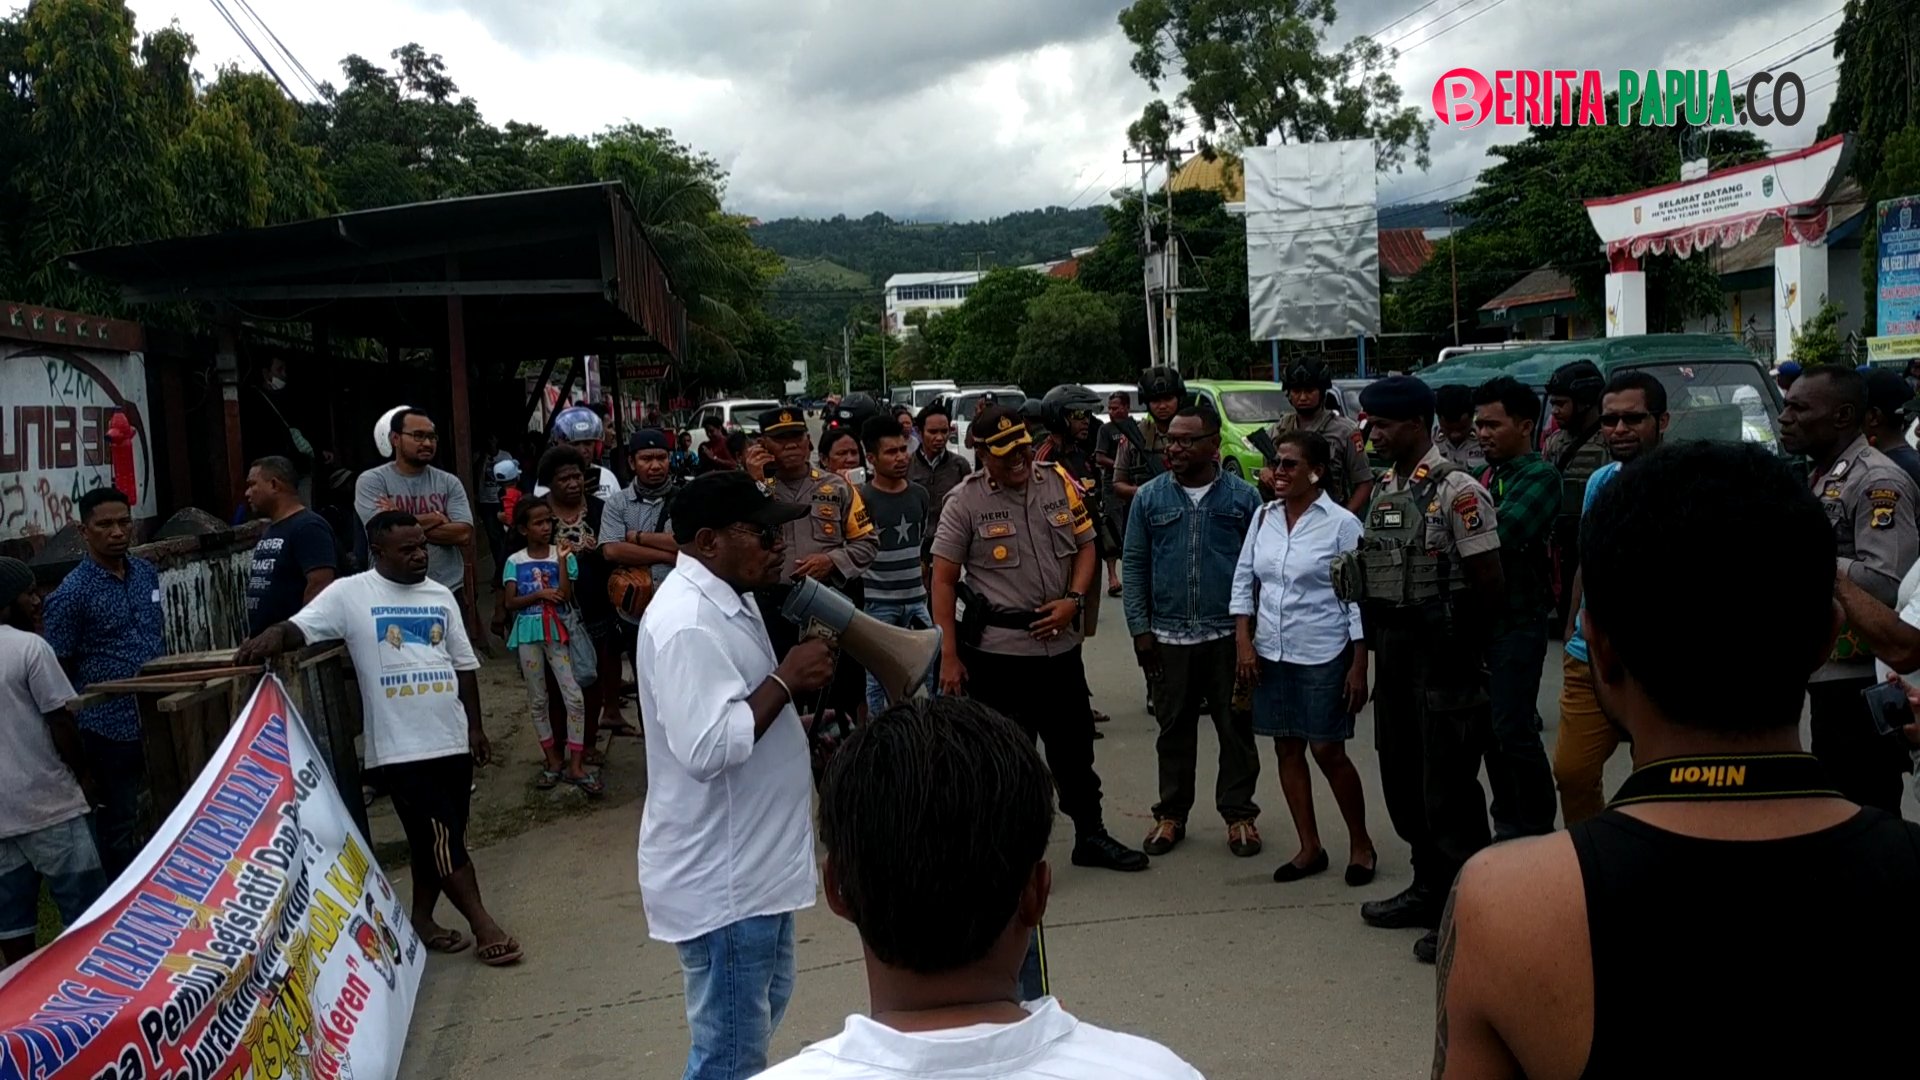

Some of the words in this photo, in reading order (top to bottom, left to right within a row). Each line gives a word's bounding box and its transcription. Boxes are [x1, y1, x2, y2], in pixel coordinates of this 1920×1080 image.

[1658, 193, 1701, 209] SELAMAT
[1703, 184, 1743, 199] DATANG
[980, 511, 1009, 521] HERU
[385, 681, 454, 699] PAPUA
[1670, 765, 1745, 787] Nikon
[76, 890, 195, 991] TARUNA
[150, 754, 283, 905] KELURAHAN
[139, 964, 224, 1068] Pemilu
[191, 862, 283, 967] Legislatif
[254, 820, 299, 872] Dan
